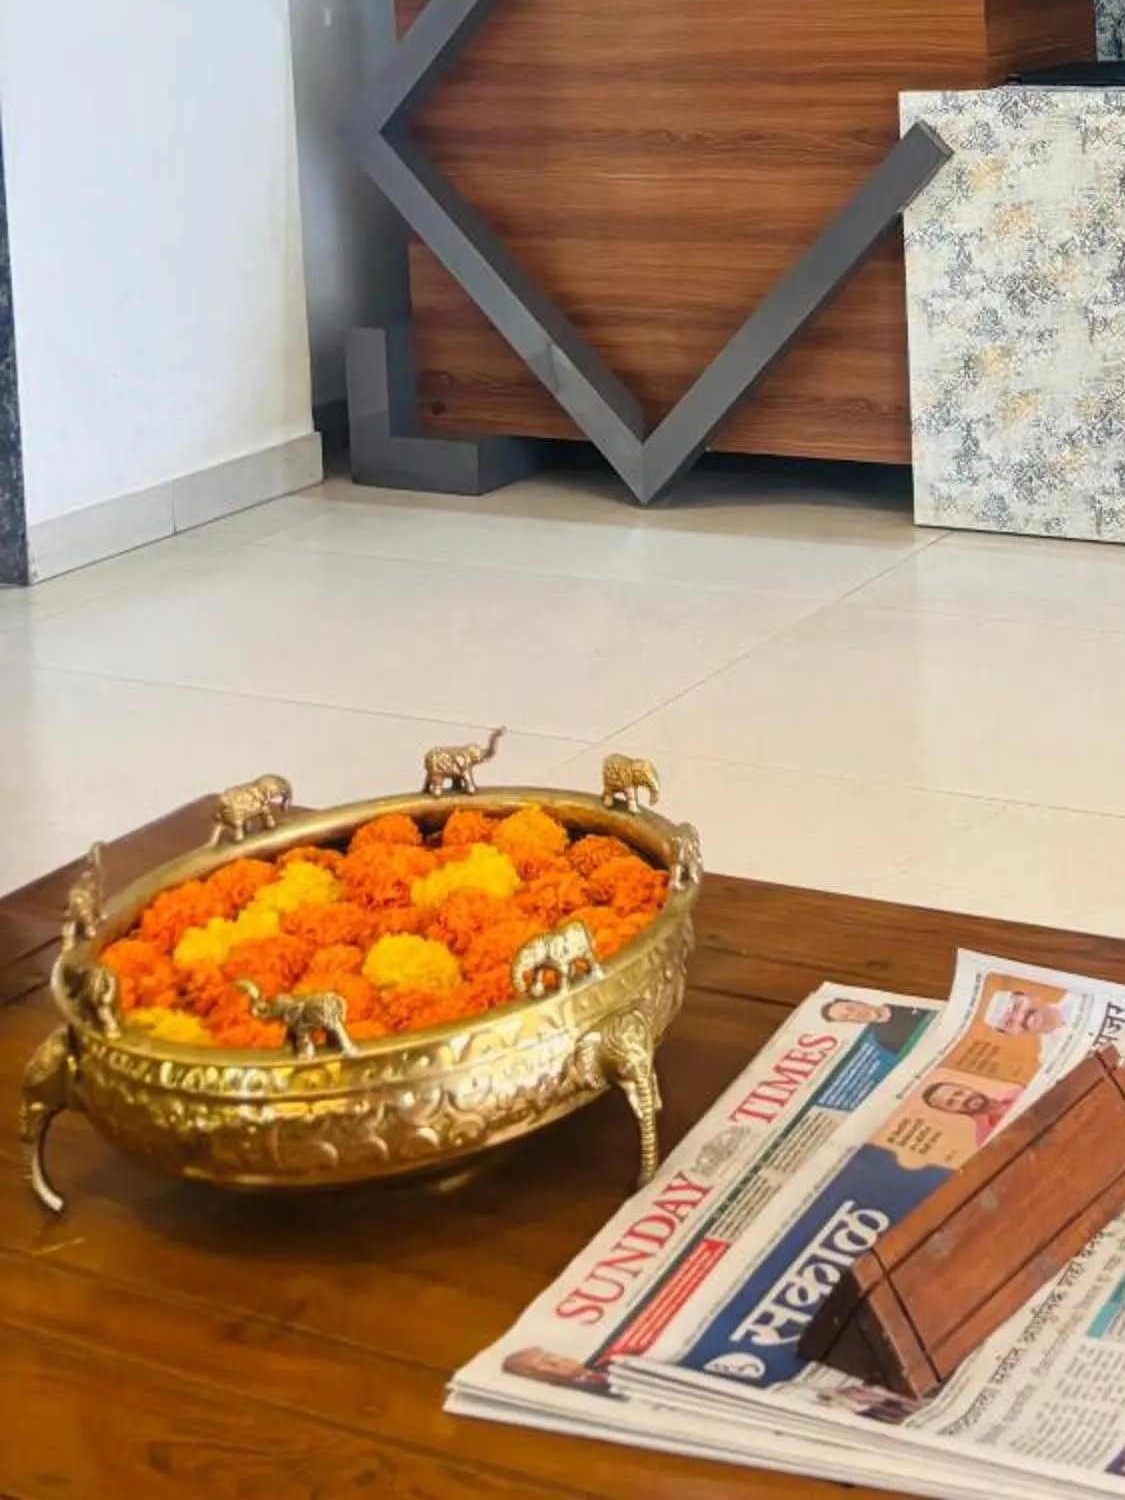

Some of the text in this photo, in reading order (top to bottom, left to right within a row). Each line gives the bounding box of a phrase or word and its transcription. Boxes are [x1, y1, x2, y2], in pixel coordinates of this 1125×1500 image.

[555, 1171, 713, 1325] SUNDAY
[729, 1033, 839, 1125] TIMES
[730, 1199, 890, 1346] सकाळ
